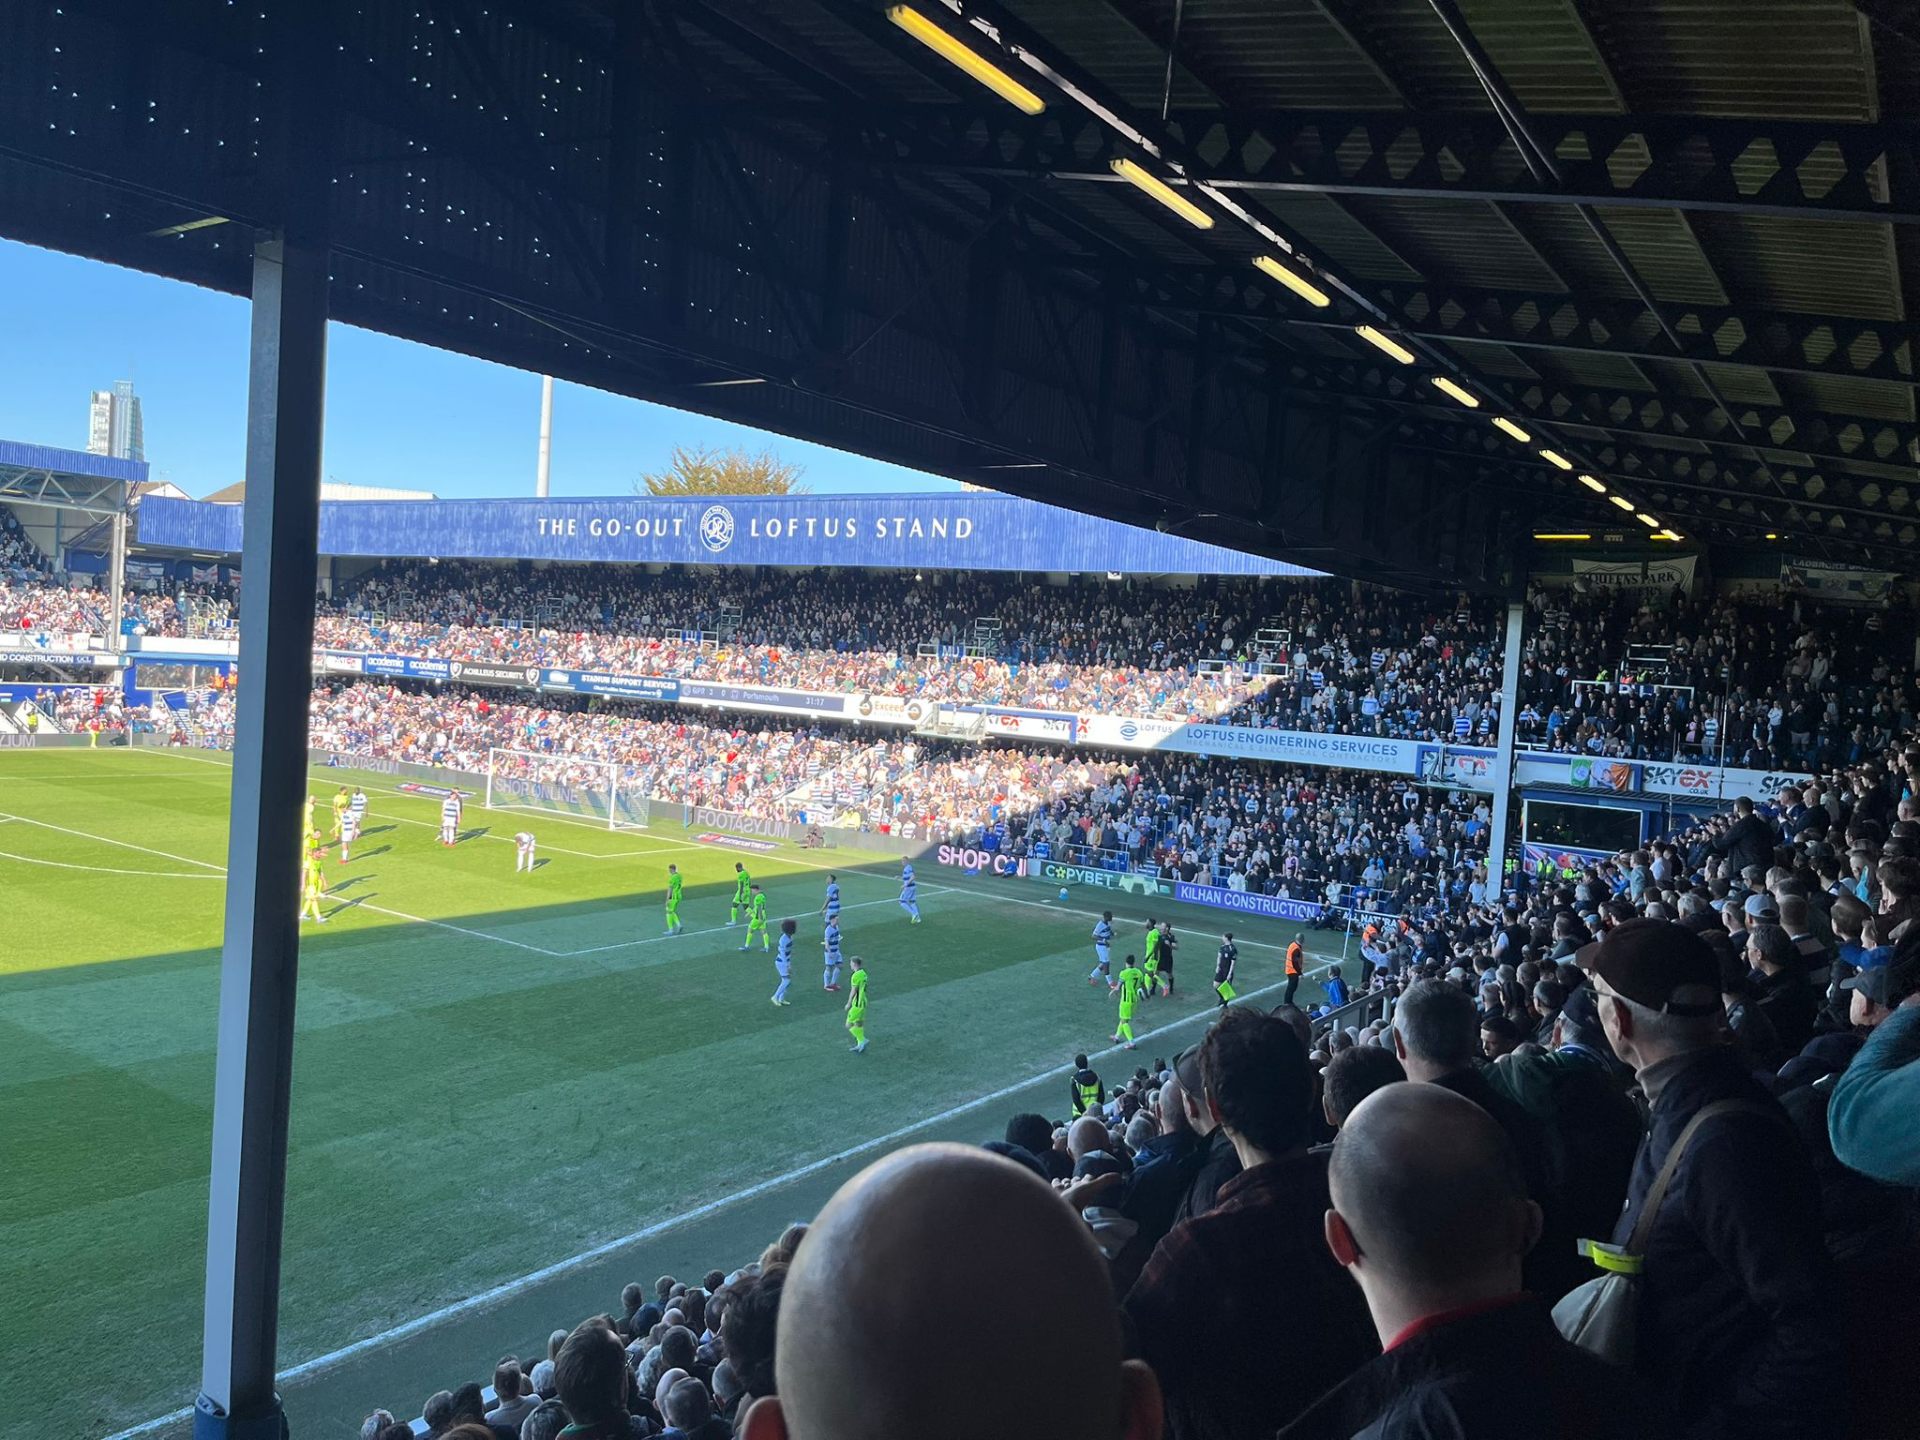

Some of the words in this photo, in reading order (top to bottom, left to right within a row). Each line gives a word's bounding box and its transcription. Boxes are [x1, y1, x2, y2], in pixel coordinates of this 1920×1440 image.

[538, 518, 577, 536] THE
[589, 518, 683, 537] GO-OUT
[750, 517, 857, 538] LOFTUS
[876, 517, 973, 538] STAND
[9, 653, 74, 663] CONSTRUCTION
[581, 674, 611, 684] STADIUM
[611, 676, 642, 687] SUPPORT
[643, 679, 677, 690] SERVICES
[1140, 723, 1174, 734] LOFTUS
[1187, 728, 1235, 742] LOFTUS
[1238, 731, 1329, 750] ENGINEERING
[1331, 740, 1399, 756] SERVICES
[495, 778, 529, 794] SHOP
[532, 783, 579, 804] ONLINE
[937, 844, 991, 871] SHOP
[1180, 885, 1222, 905] KILHAN
[1223, 891, 1316, 919] CONSTRUCTION
